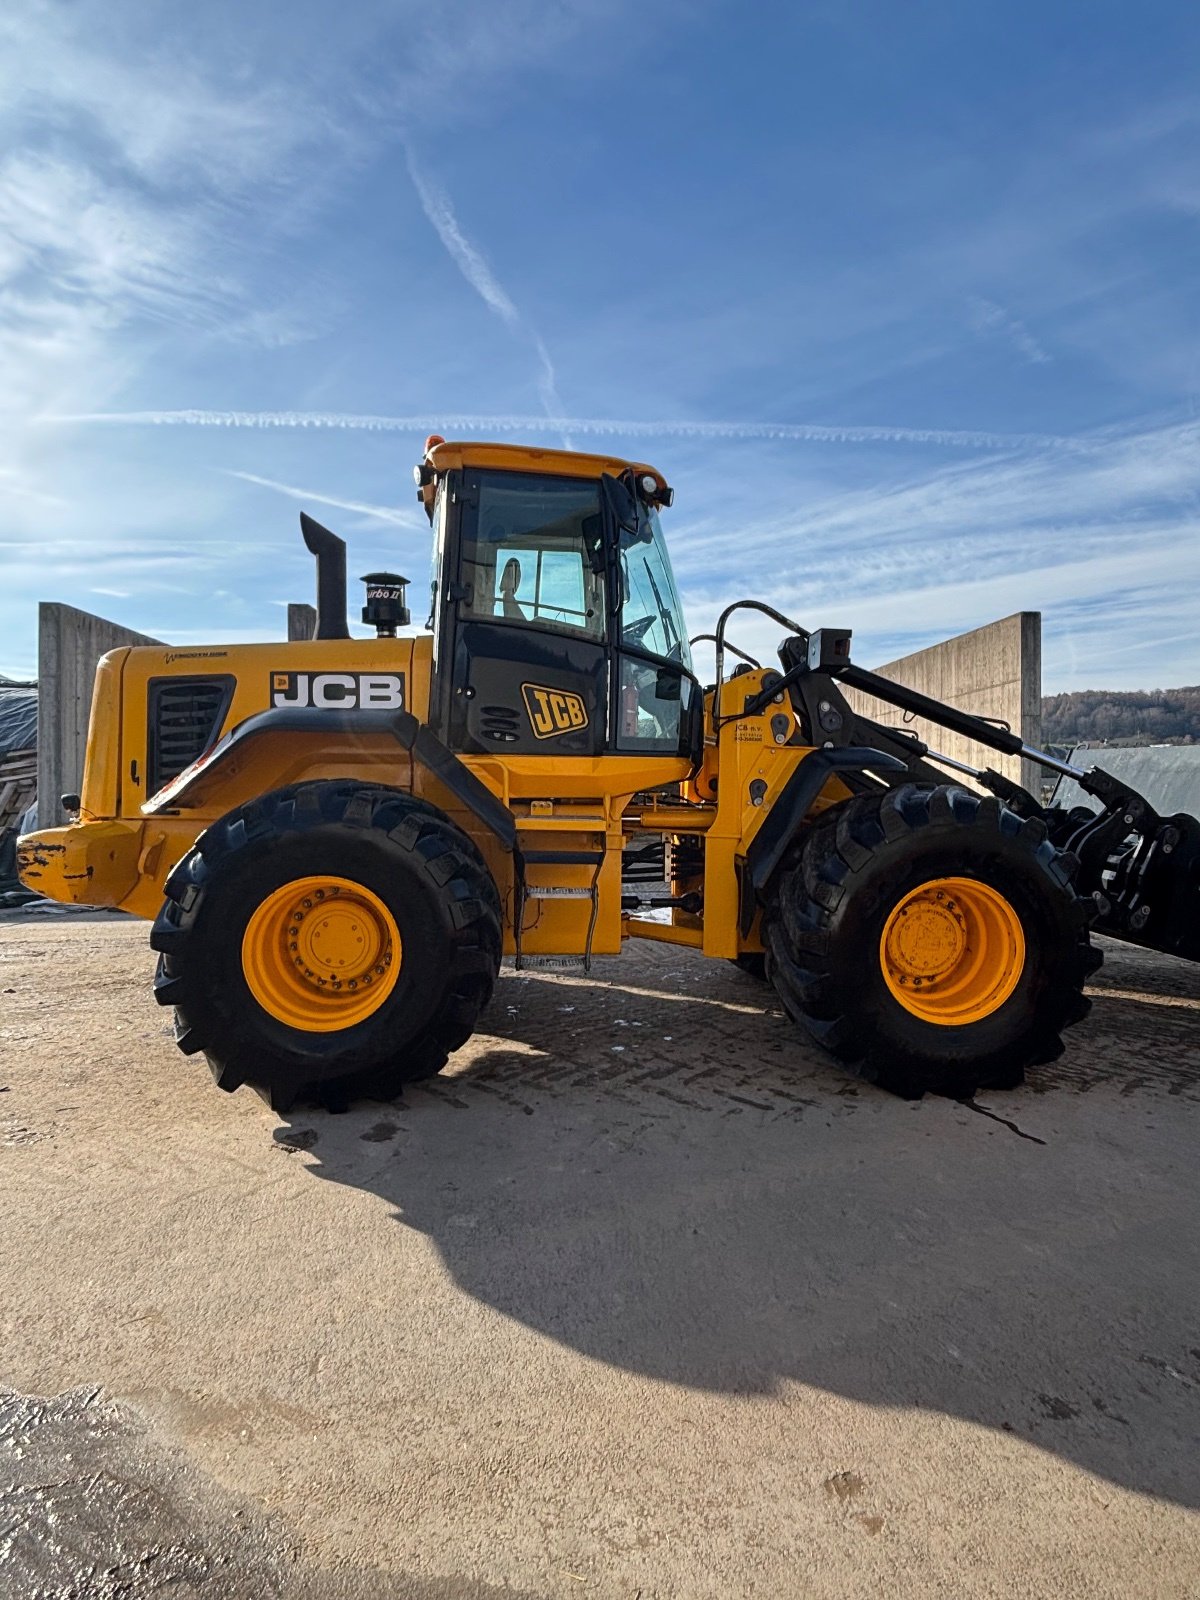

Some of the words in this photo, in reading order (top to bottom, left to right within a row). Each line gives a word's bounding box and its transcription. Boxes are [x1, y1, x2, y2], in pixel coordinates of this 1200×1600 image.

[367, 588, 390, 599] urbo
[273, 674, 403, 709] JCB
[533, 690, 584, 733] JCB
